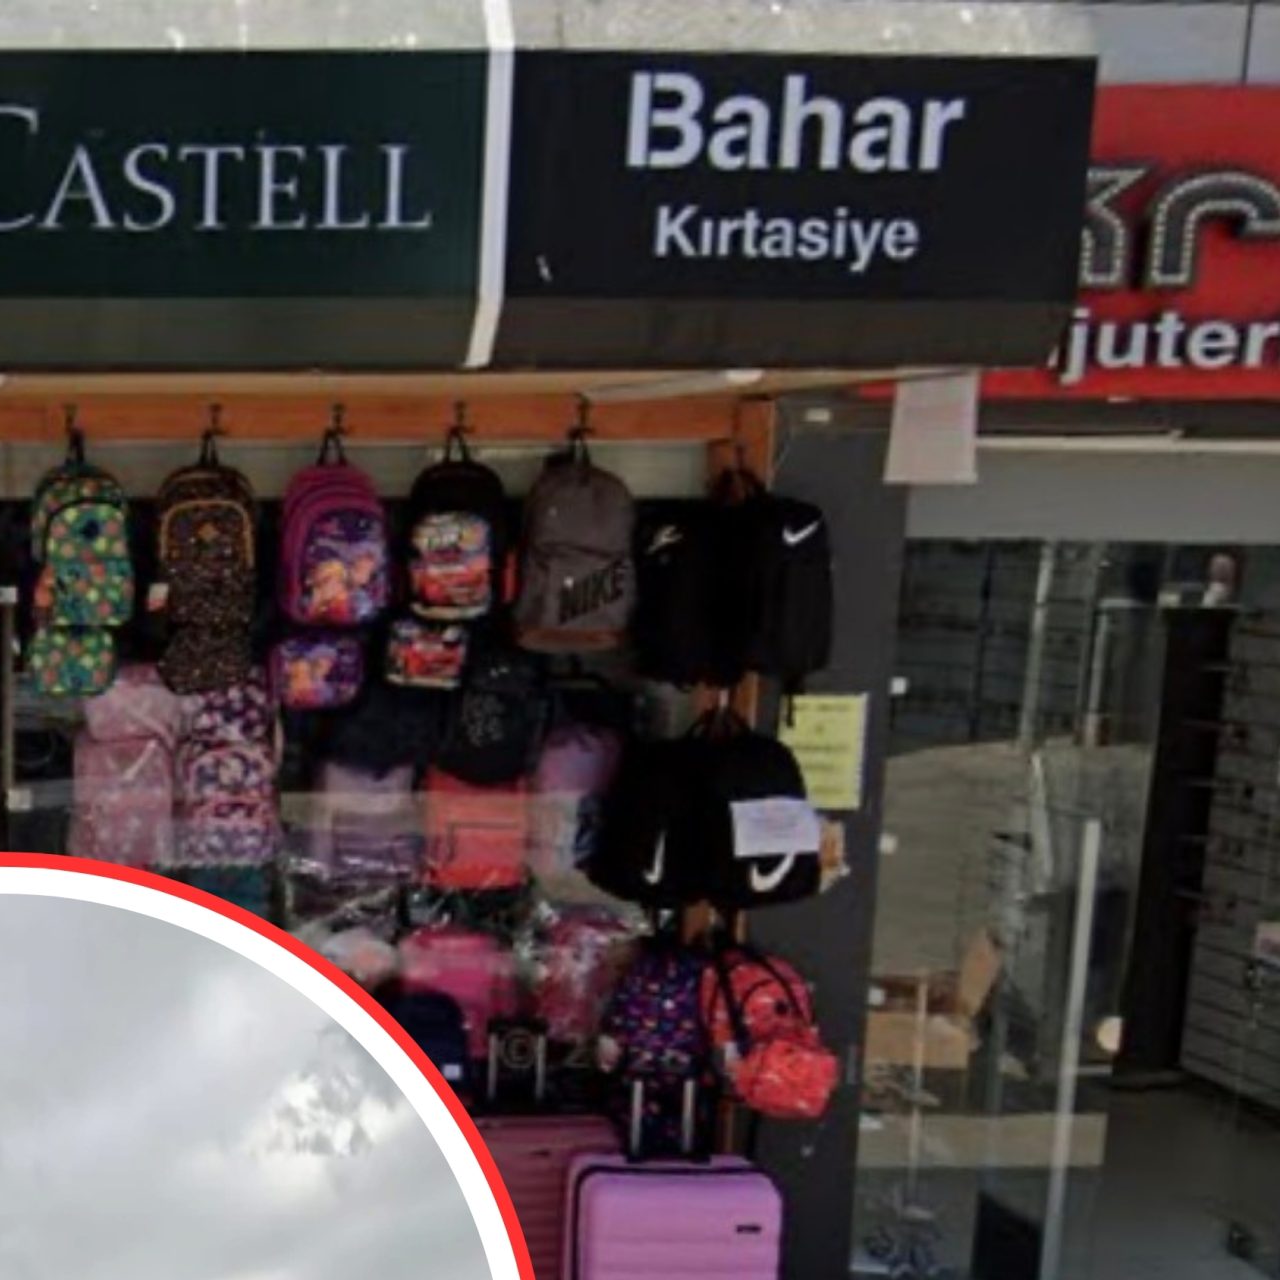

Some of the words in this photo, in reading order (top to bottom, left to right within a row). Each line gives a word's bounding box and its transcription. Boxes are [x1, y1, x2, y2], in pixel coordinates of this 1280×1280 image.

[624, 71, 966, 173] Bahar
[653, 204, 920, 273] Kırtasiye
[1046, 305, 1280, 387] juter
[558, 557, 629, 626] NIKE
